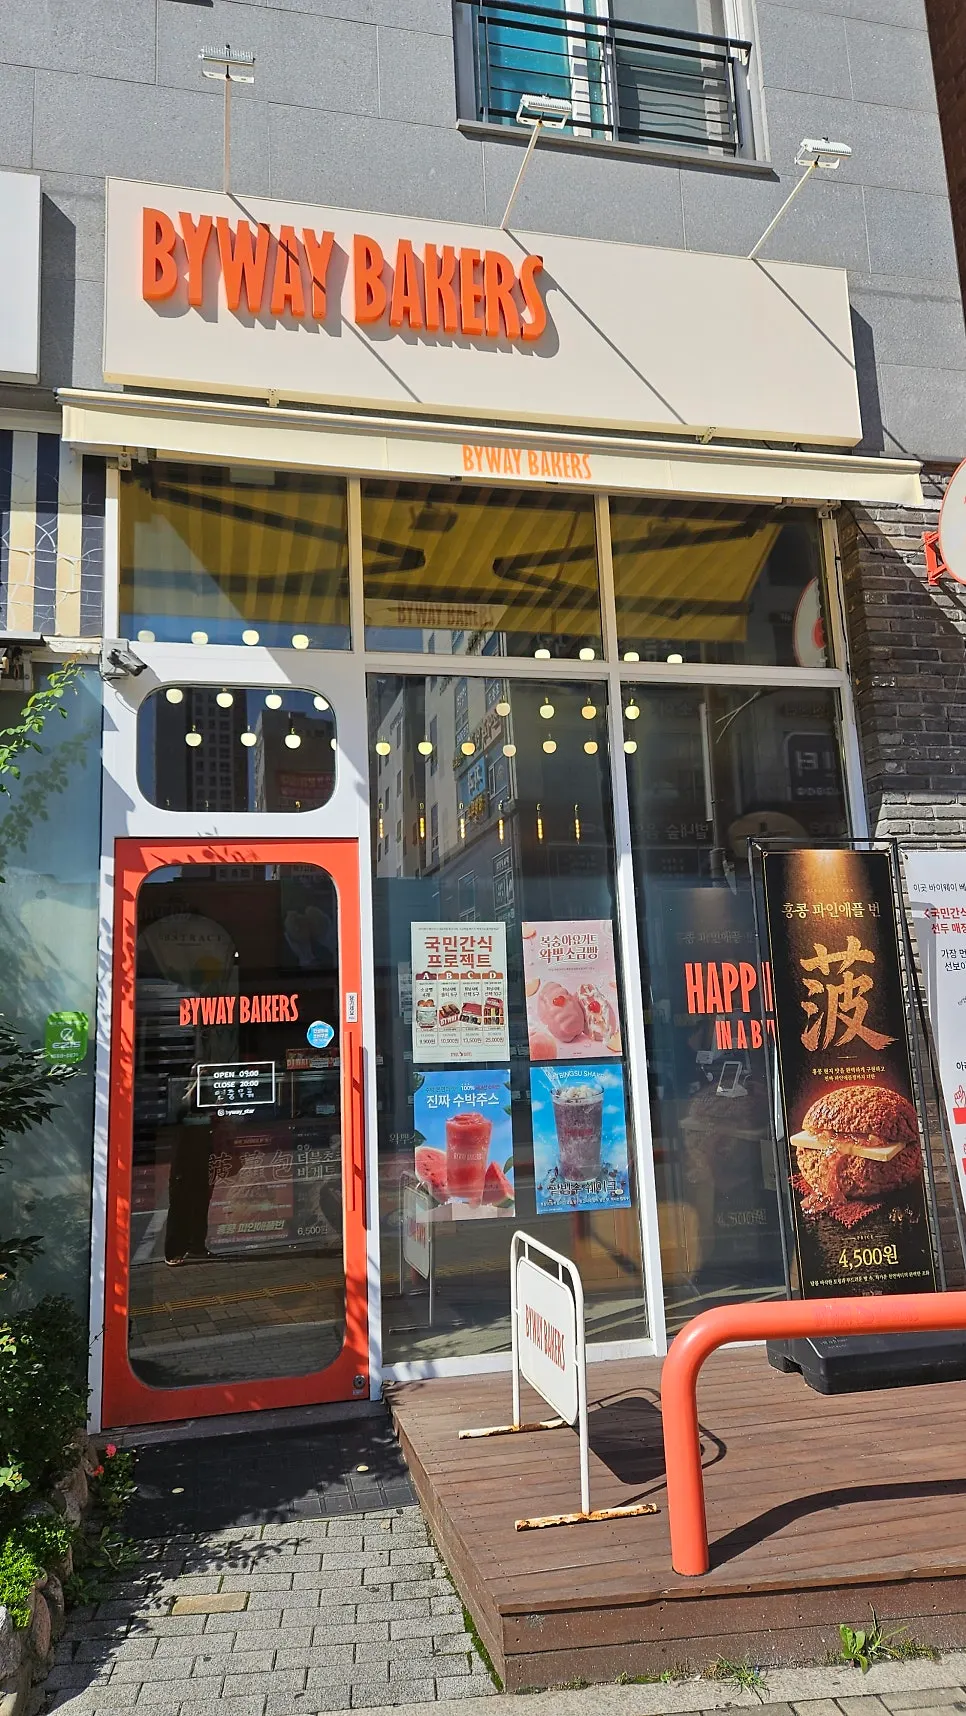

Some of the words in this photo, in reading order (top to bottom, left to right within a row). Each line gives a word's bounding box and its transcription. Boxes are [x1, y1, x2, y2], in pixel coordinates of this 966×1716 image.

[142, 206, 335, 319] BYWAY
[353, 233, 547, 341] BAKERS
[462, 444, 522, 475] BYWAY
[527, 449, 592, 480] BAKERS
[781, 902, 809, 919] 홍콩
[812, 901, 865, 918] 파인애플
[868, 901, 881, 918] 번
[931, 923, 949, 934] 선두
[424, 935, 493, 953] 국민간식
[541, 933, 597, 948] 복숭아요거트
[427, 953, 492, 969] 프로젝트
[941, 949, 957, 959] 가장
[422, 971, 430, 980] A
[446, 971, 453, 980] B
[467, 971, 474, 980] C
[489, 971, 496, 979] D
[800, 936, 899, 1051] 菠
[180, 996, 235, 1026] BYWAY
[240, 994, 298, 1023] BAKERS
[715, 1021, 732, 1049] IN
[737, 1020, 748, 1049] A
[213, 1081, 236, 1089] CLOSE
[427, 1093, 451, 1109] 진짜
[452, 1092, 500, 1107] 수박주스
[839, 1244, 900, 1270] 4,500원
[526, 1304, 543, 1351] BYWAY
[544, 1319, 566, 1372] BAKERS
